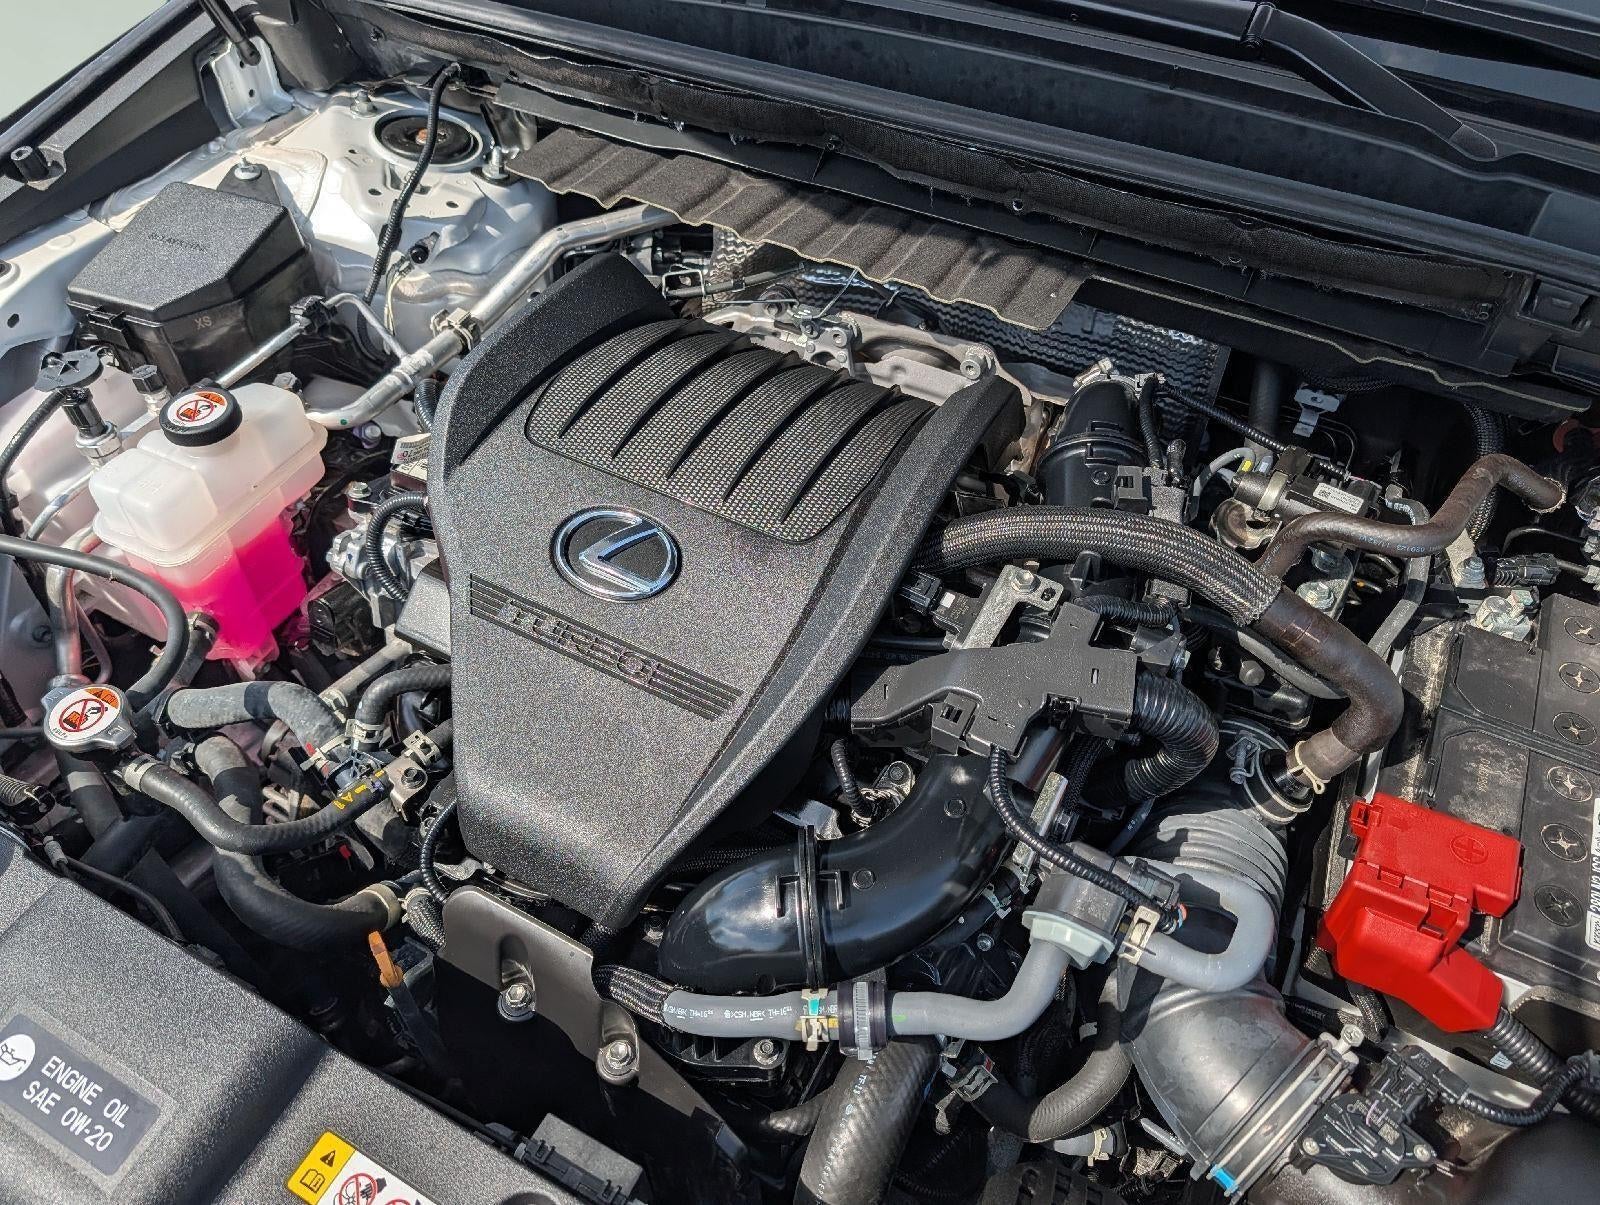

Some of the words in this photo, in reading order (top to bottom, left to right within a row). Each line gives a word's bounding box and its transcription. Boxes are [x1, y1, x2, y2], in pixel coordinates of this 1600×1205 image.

[22, 1080, 62, 1115] SAE
[60, 1106, 114, 1152] 0W-20
[41, 1056, 103, 1106] ENGINE
[103, 1098, 130, 1129] OIL
